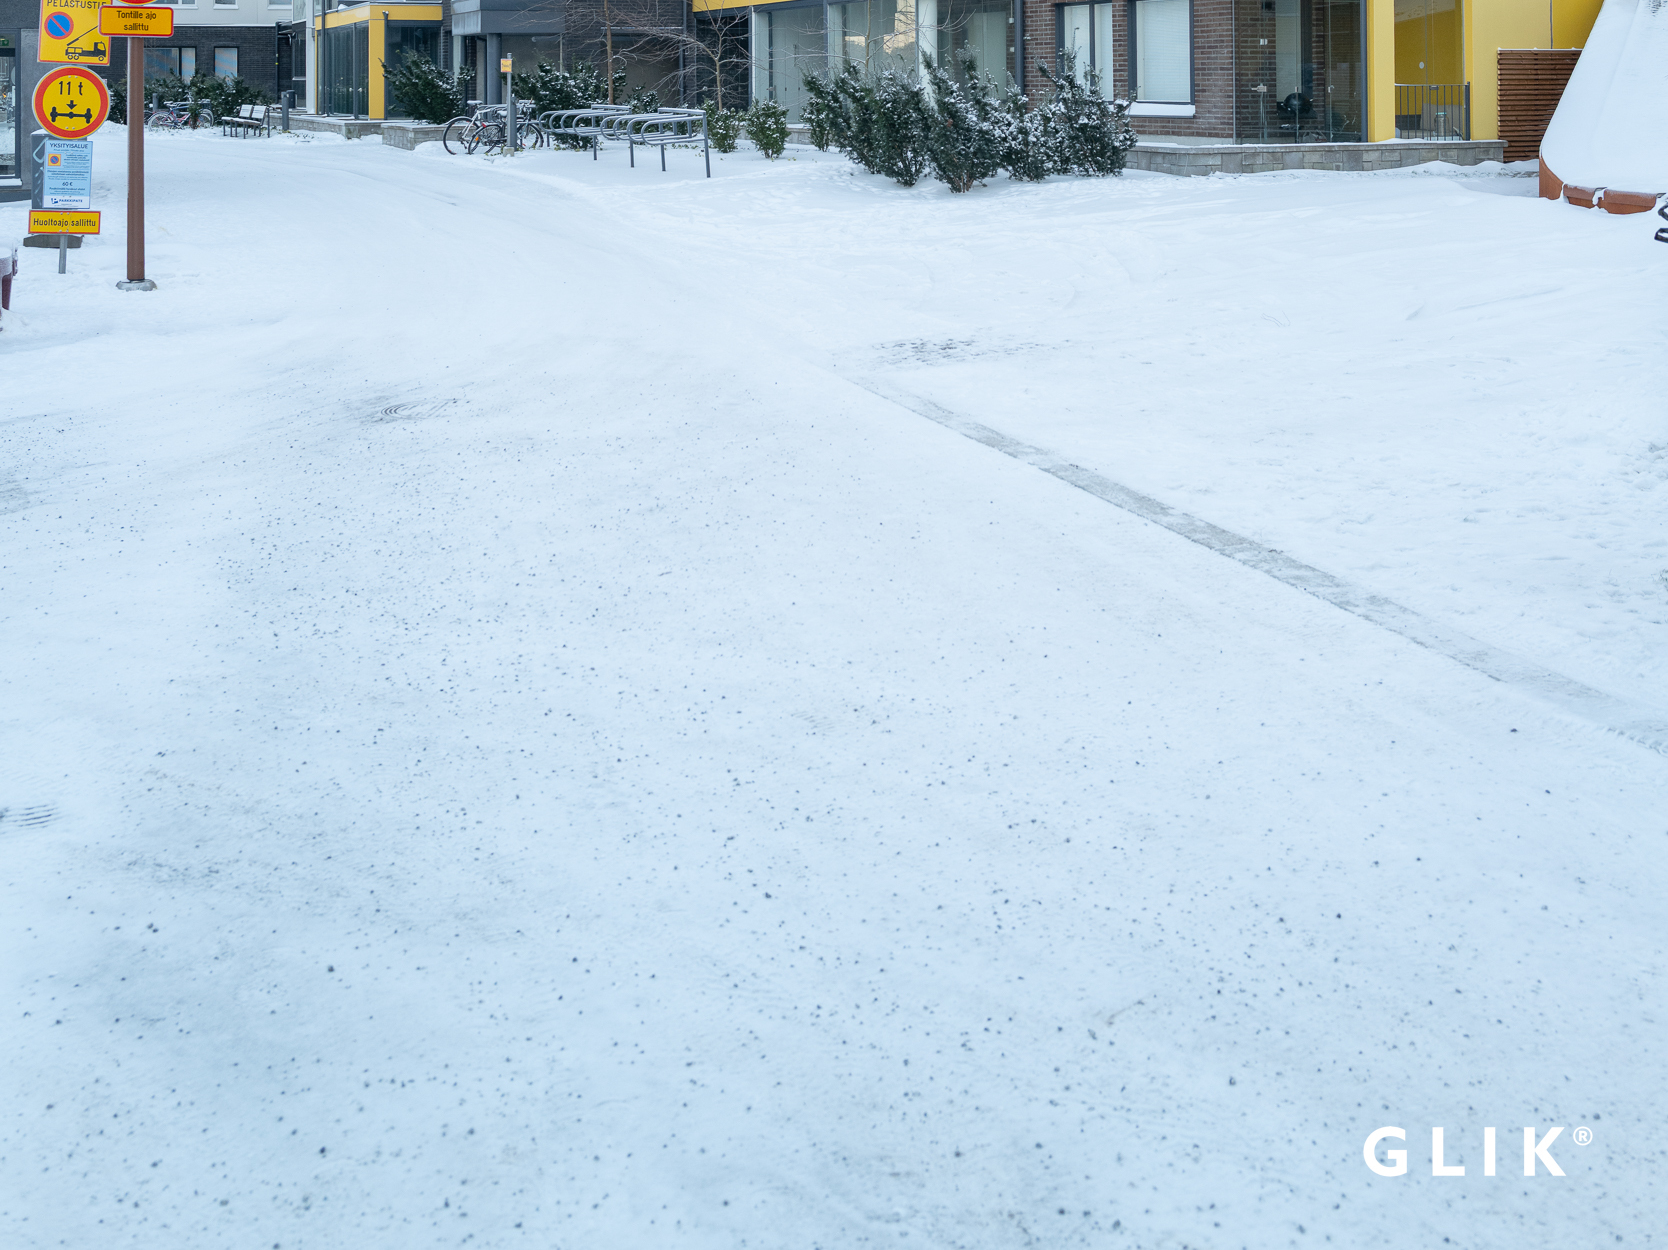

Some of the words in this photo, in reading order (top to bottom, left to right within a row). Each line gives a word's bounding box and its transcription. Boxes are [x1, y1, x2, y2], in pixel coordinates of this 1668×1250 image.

[116, 10, 143, 19] Tontille
[145, 10, 157, 21] ajo
[123, 23, 149, 31] sallittu
[58, 80, 71, 96] 11
[78, 81, 83, 96] t
[33, 218, 69, 227] Huoltoajo
[70, 218, 96, 227] sallittu
